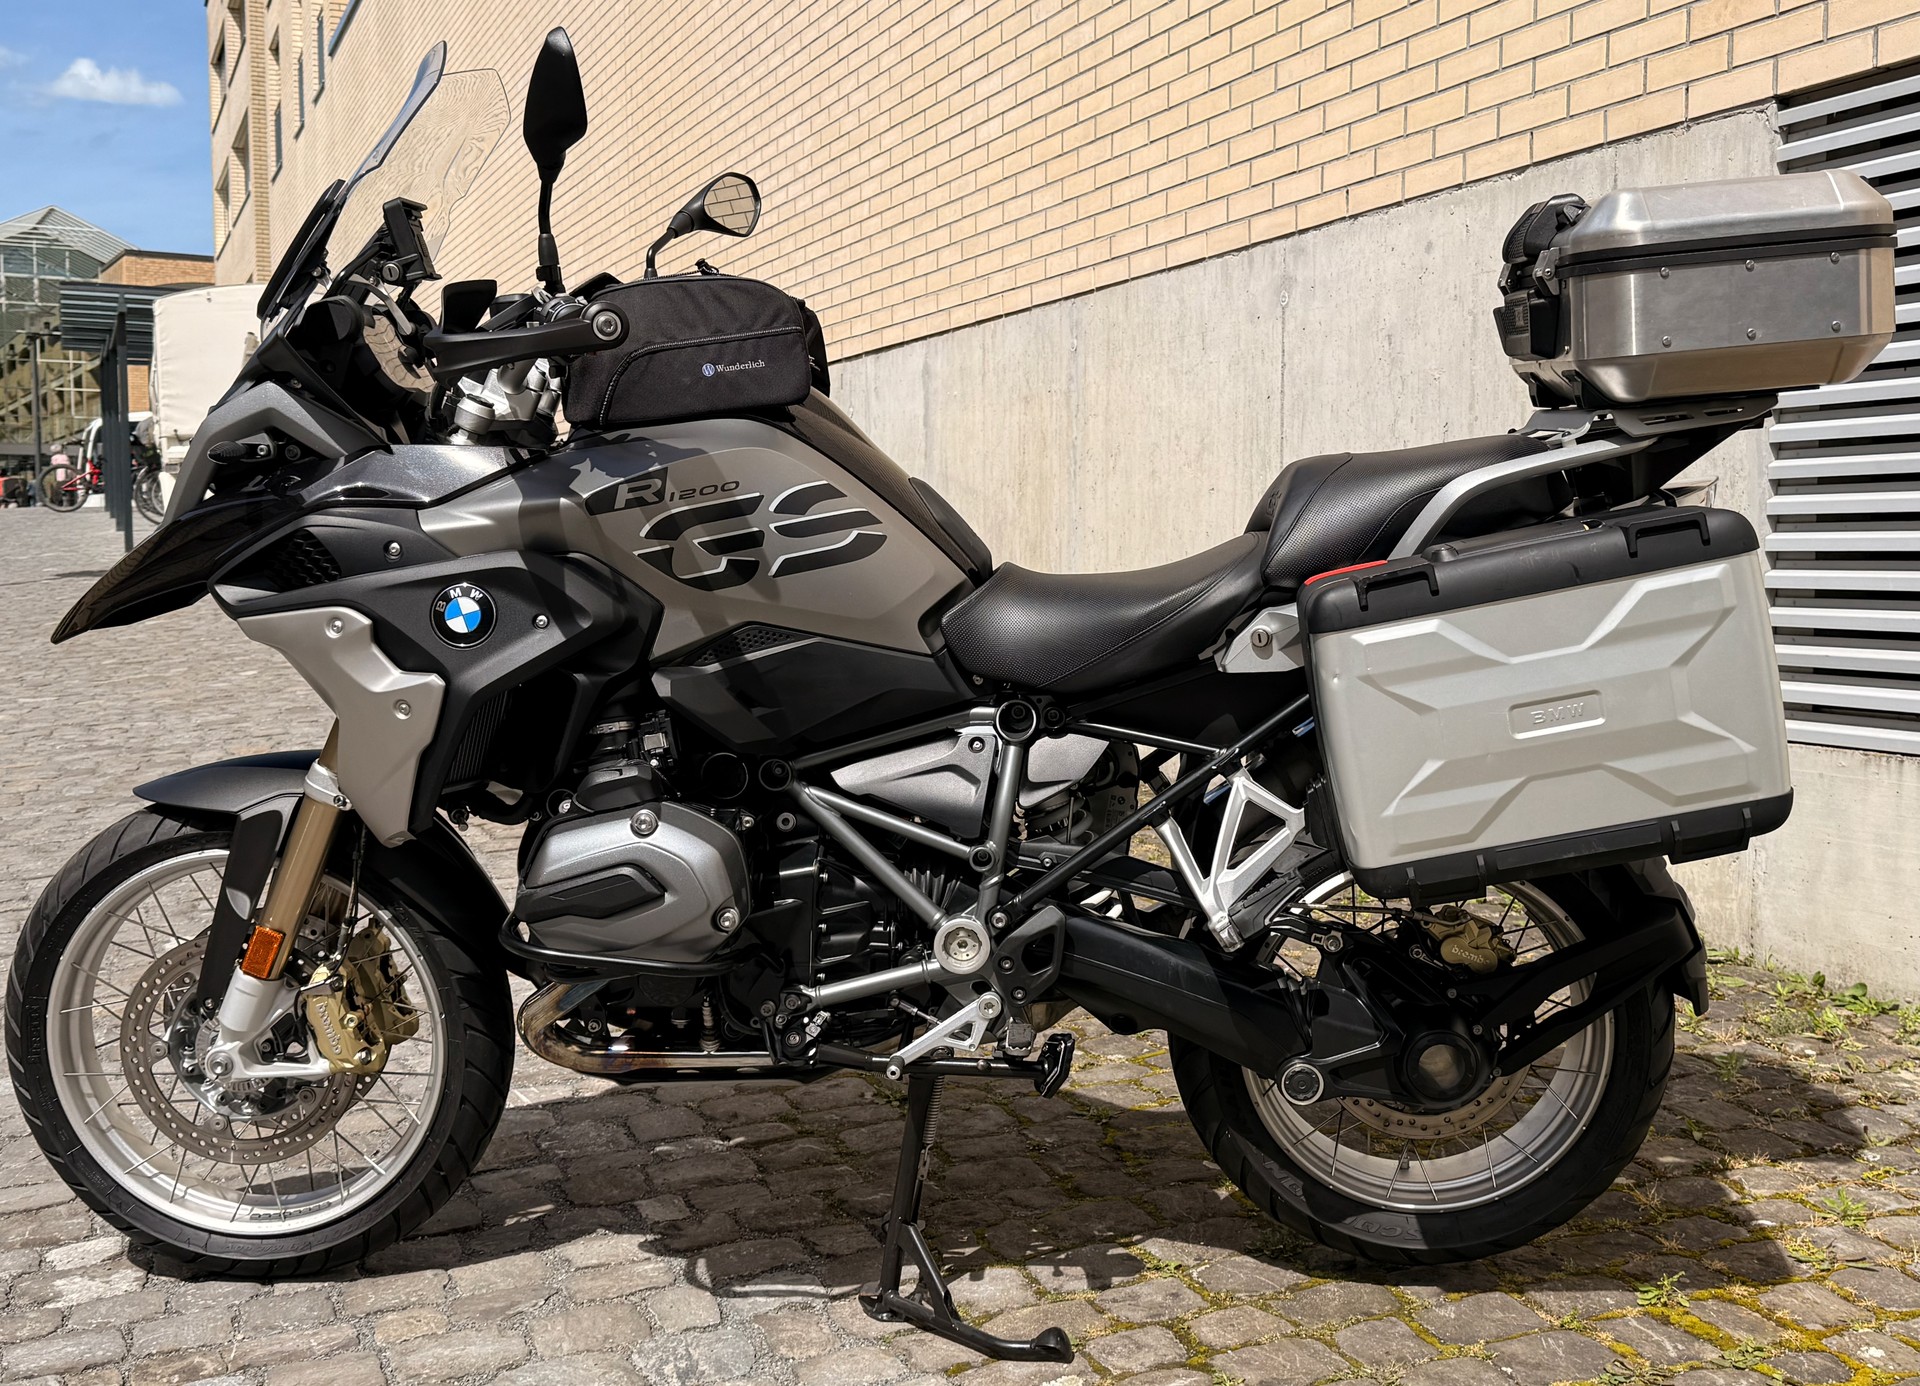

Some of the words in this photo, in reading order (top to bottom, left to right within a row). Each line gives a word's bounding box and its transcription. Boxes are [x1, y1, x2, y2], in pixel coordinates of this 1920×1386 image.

[716, 360, 766, 373] Wunderlich
[613, 478, 664, 511] R
[669, 480, 740, 503] 1200
[632, 480, 888, 592] GS
[435, 587, 484, 613] BMW
[1530, 702, 1584, 725] BMW
